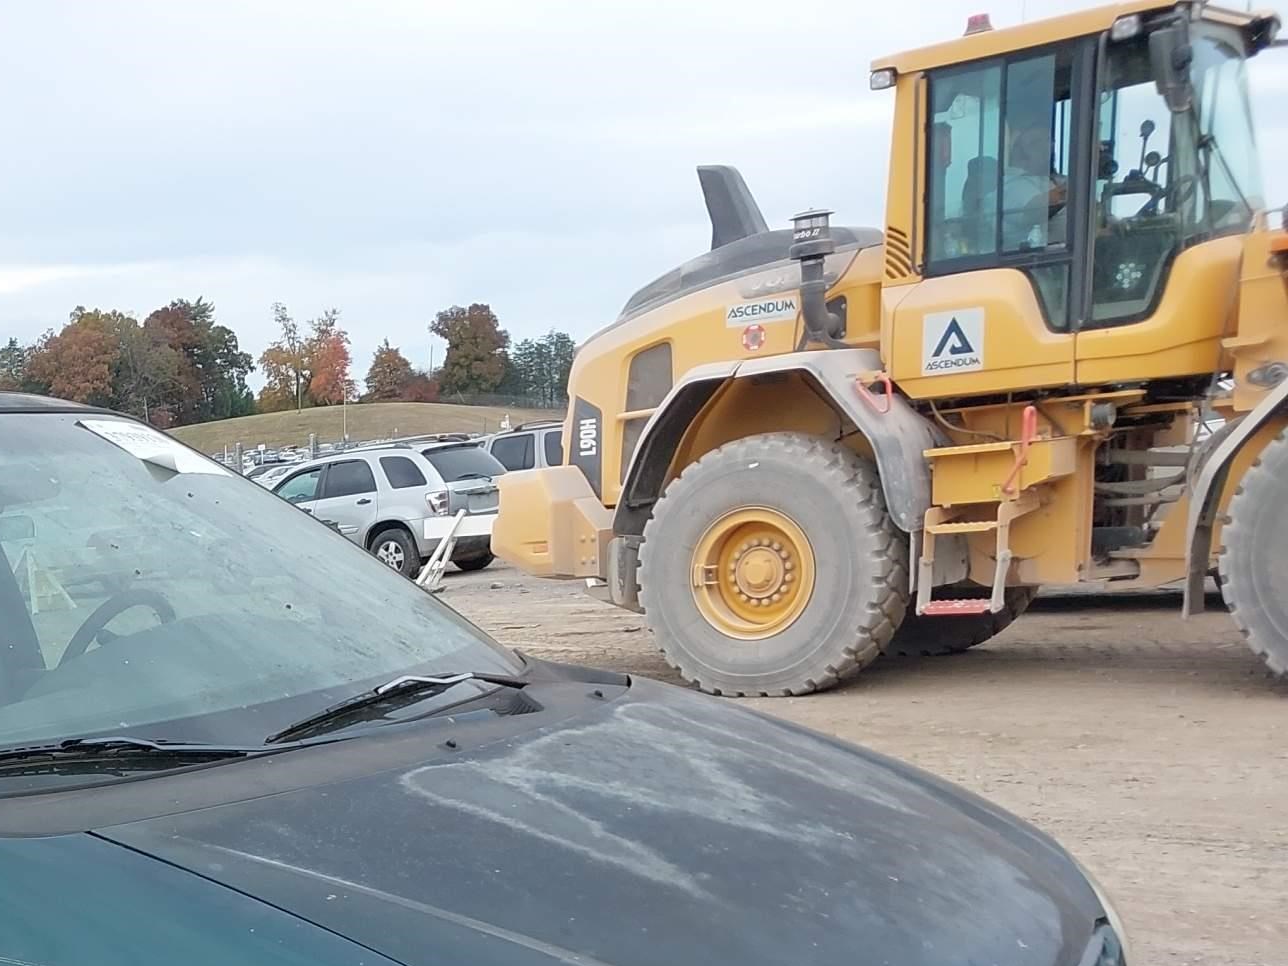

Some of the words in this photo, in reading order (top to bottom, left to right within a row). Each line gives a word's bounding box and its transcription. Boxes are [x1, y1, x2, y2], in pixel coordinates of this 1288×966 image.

[727, 299, 795, 319] ASCENDUM
[925, 357, 981, 371] ASCENDUM
[579, 418, 597, 456] L90H
